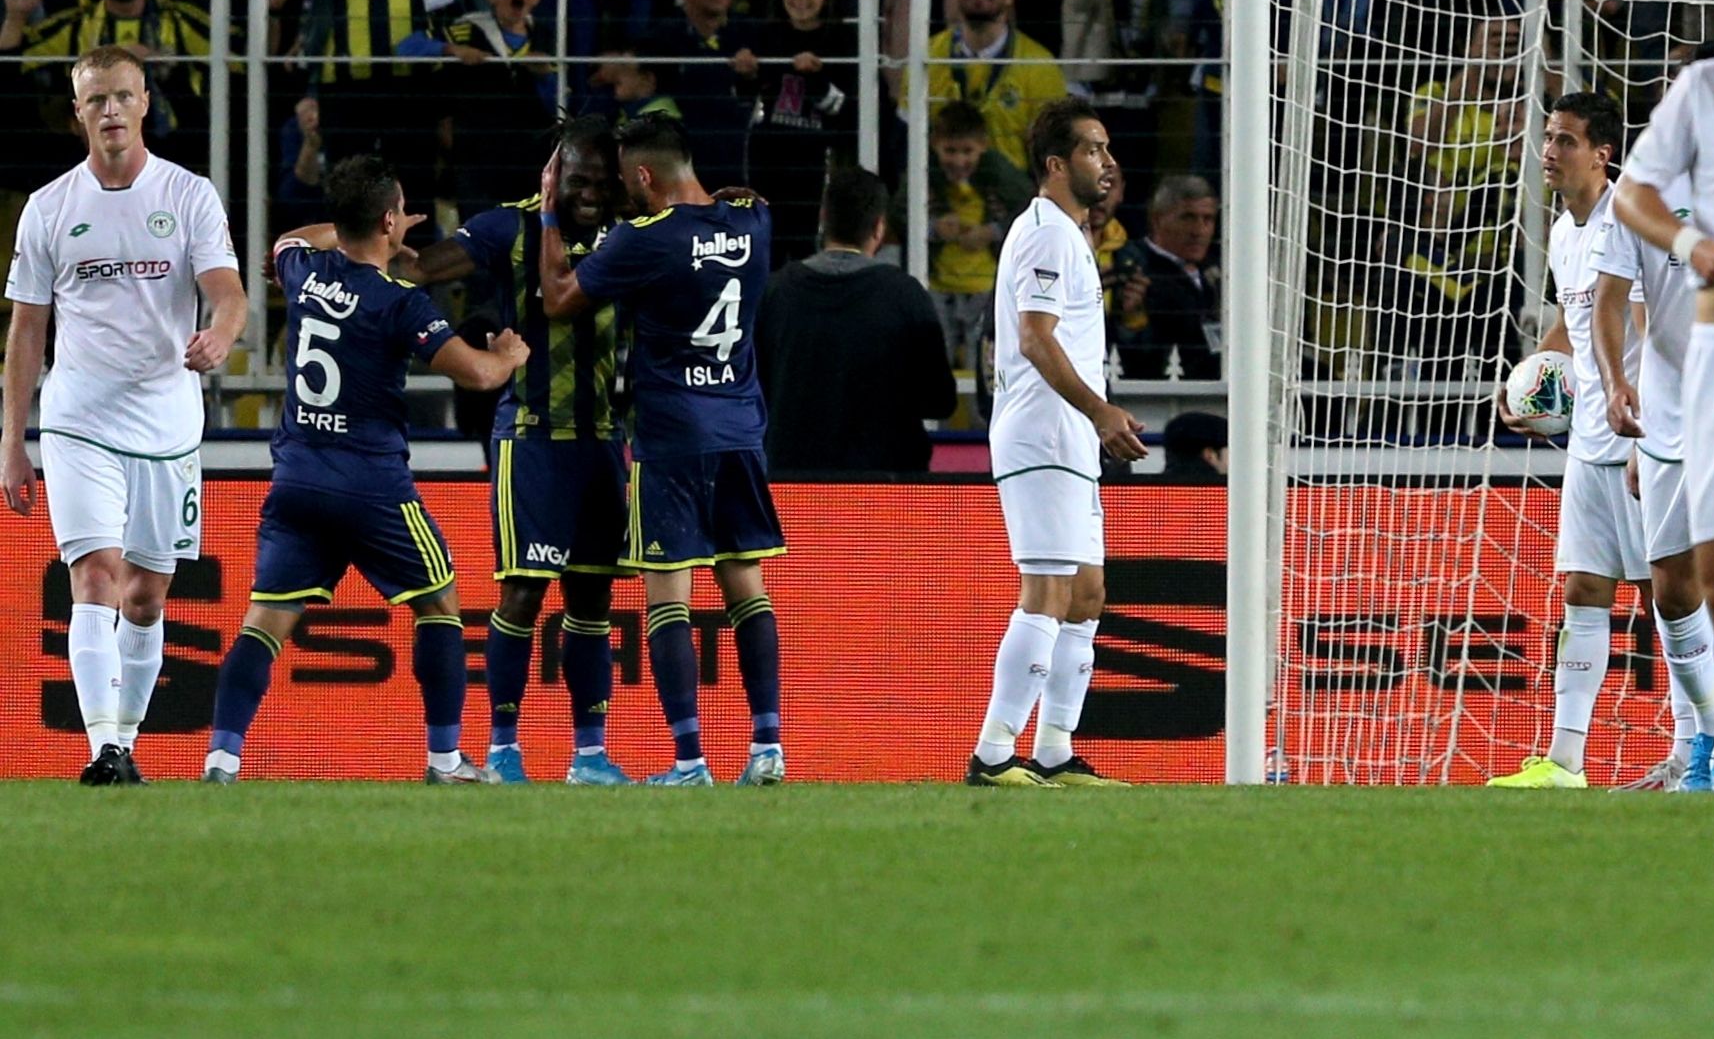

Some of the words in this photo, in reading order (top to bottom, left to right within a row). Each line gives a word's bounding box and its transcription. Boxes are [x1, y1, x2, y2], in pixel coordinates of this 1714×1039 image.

[691, 232, 751, 267] halley
[300, 272, 360, 319] halley
[690, 278, 743, 362] 4
[295, 315, 341, 407] 5
[685, 364, 735, 386] ISLA
[182, 487, 198, 527] 6
[291, 608, 732, 685] SAT
